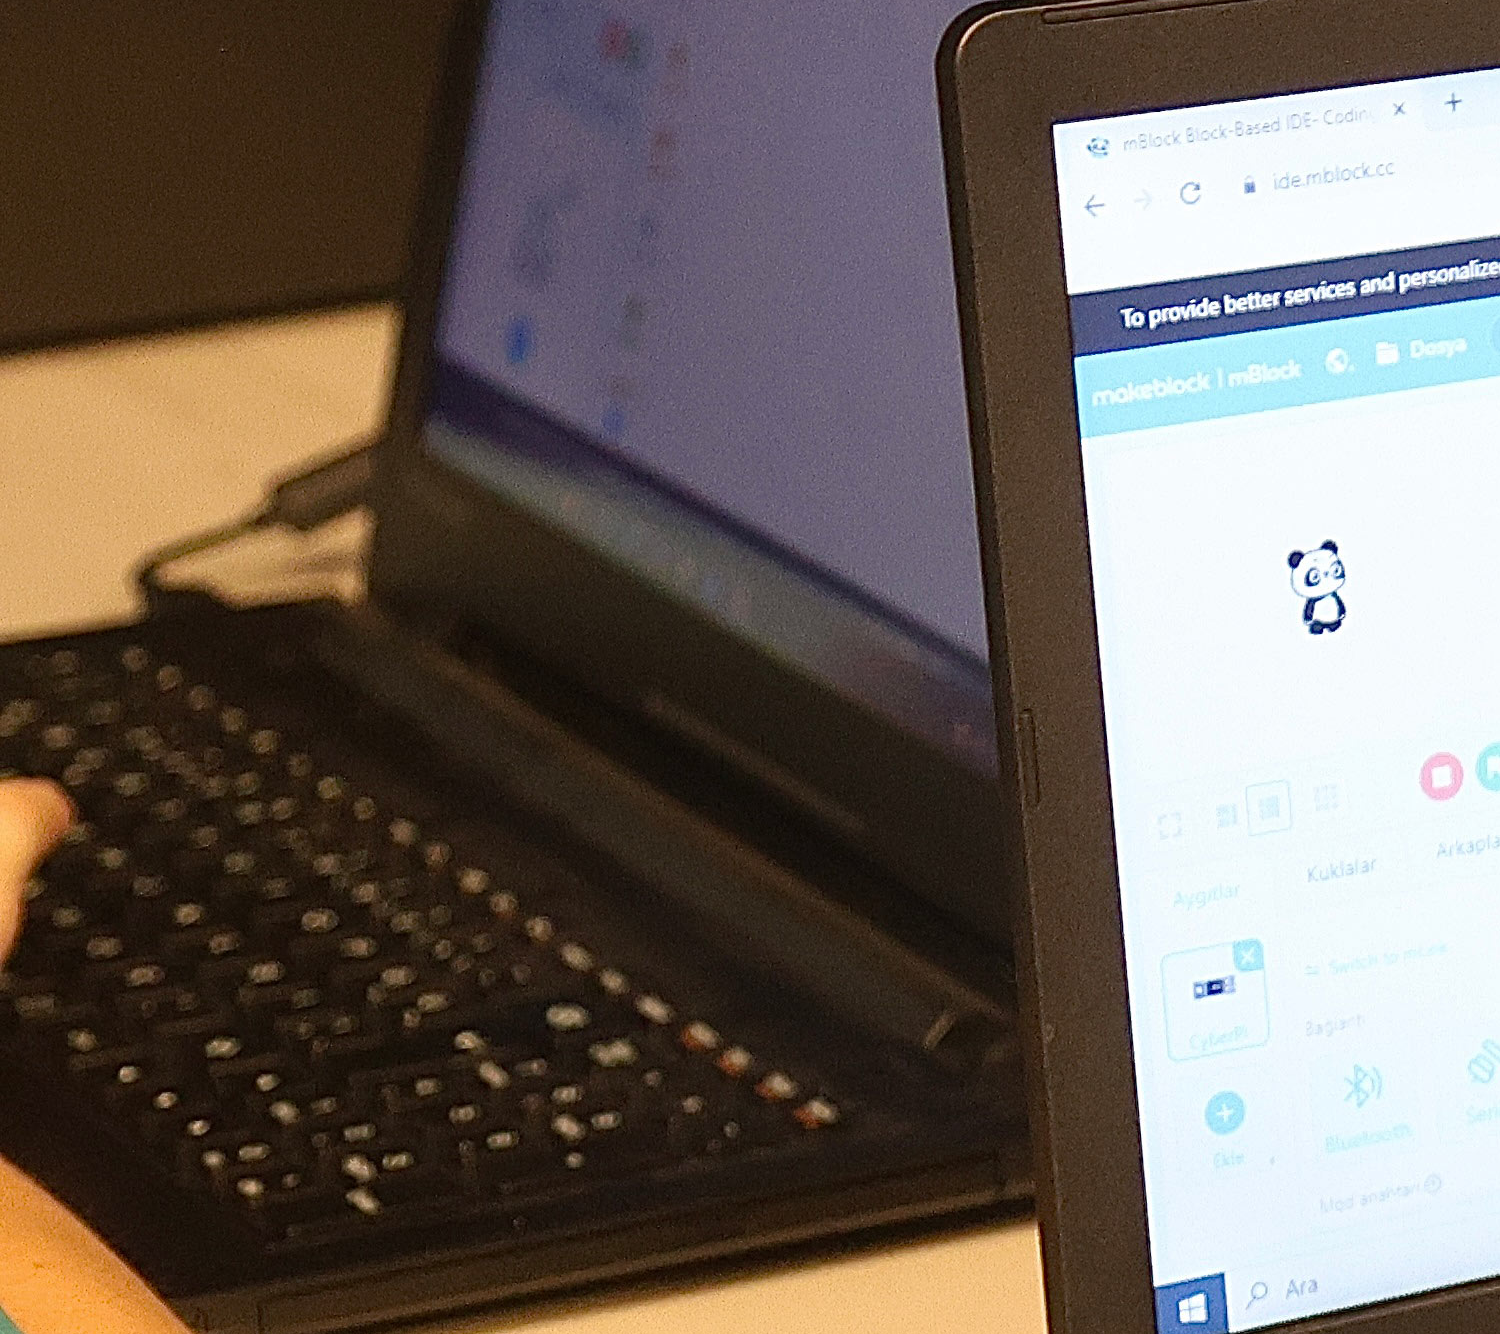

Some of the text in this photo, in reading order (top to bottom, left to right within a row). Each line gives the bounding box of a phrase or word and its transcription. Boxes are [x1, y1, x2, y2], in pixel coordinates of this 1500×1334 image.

[1123, 131, 1180, 151] mBlock
[1186, 117, 1280, 143] Block-Based
[1273, 160, 1396, 191] ide.mblock.cc
[1119, 306, 1145, 329] To
[1148, 298, 1220, 330] provide
[1224, 290, 1281, 317] better
[1285, 280, 1356, 308] services
[1360, 271, 1395, 295] and
[1410, 336, 1468, 360] Dosya
[1092, 359, 1302, 407] makeblock mBlock
[1306, 856, 1378, 884] Kuklalar
[1172, 881, 1241, 910] Aygıtlar
[1324, 1122, 1412, 1154] Bluetooth
[1285, 1275, 1319, 1299] Ara
